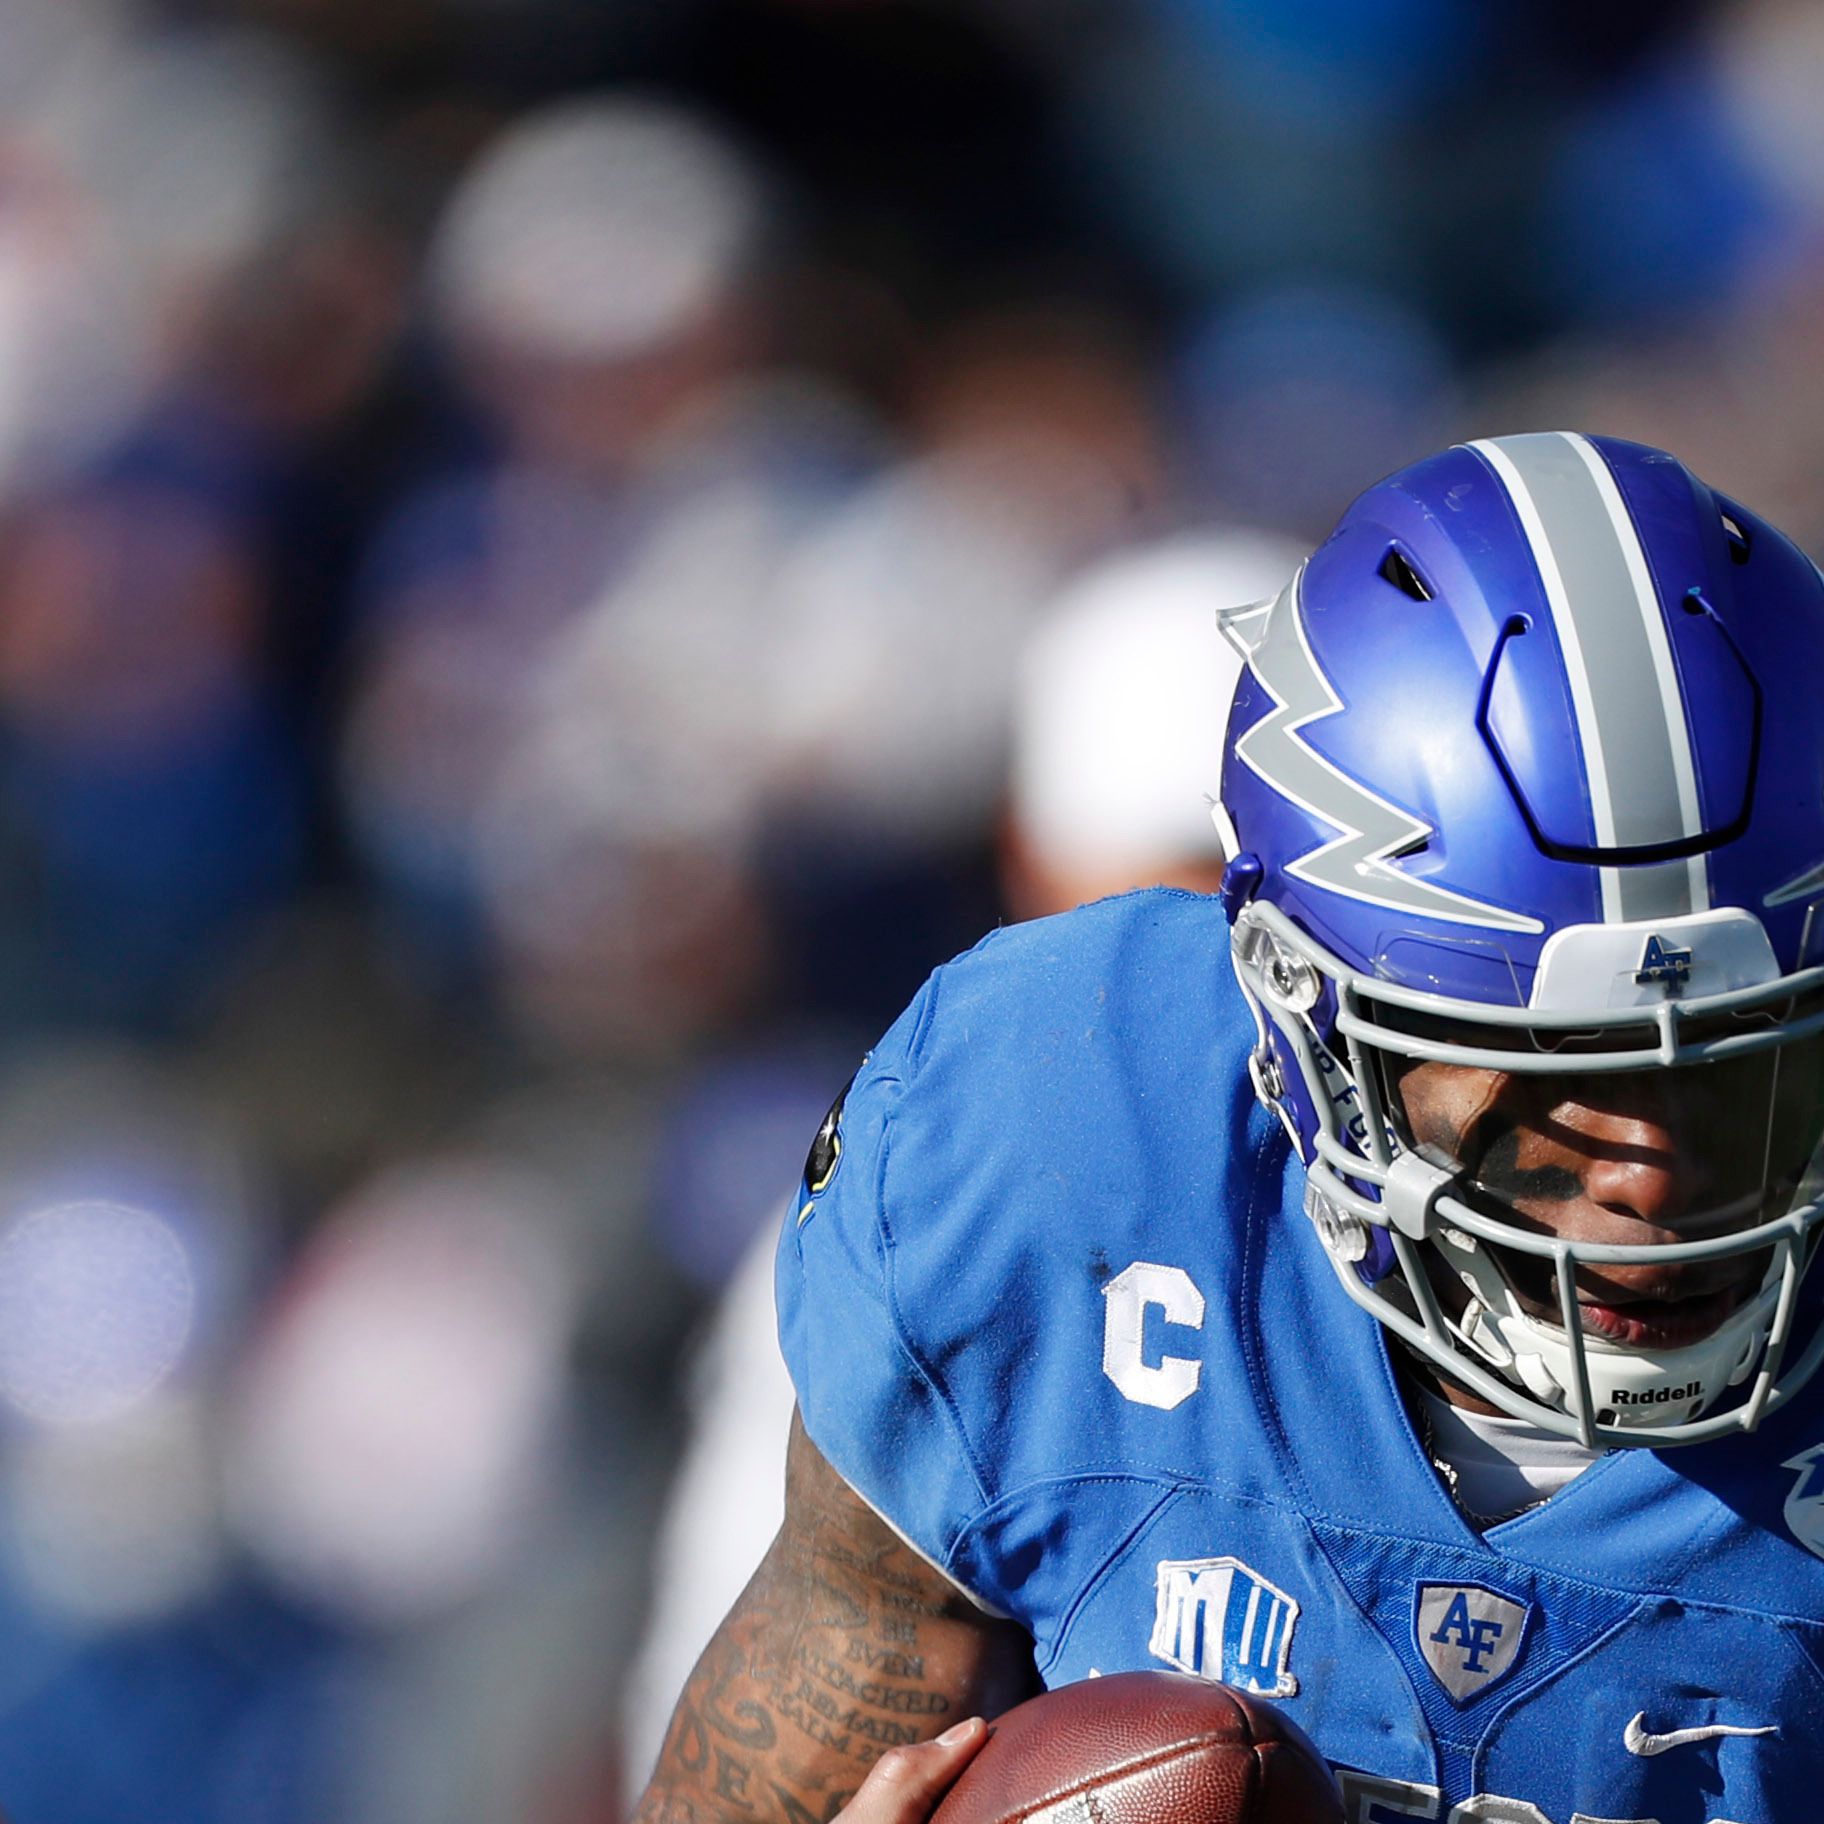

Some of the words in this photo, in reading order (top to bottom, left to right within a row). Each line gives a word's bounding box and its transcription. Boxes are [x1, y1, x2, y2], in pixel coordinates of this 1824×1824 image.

[1102, 1261, 1206, 1410] C
[1611, 1381, 1702, 1405] Riddell
[1429, 1591, 1503, 1674] AF
